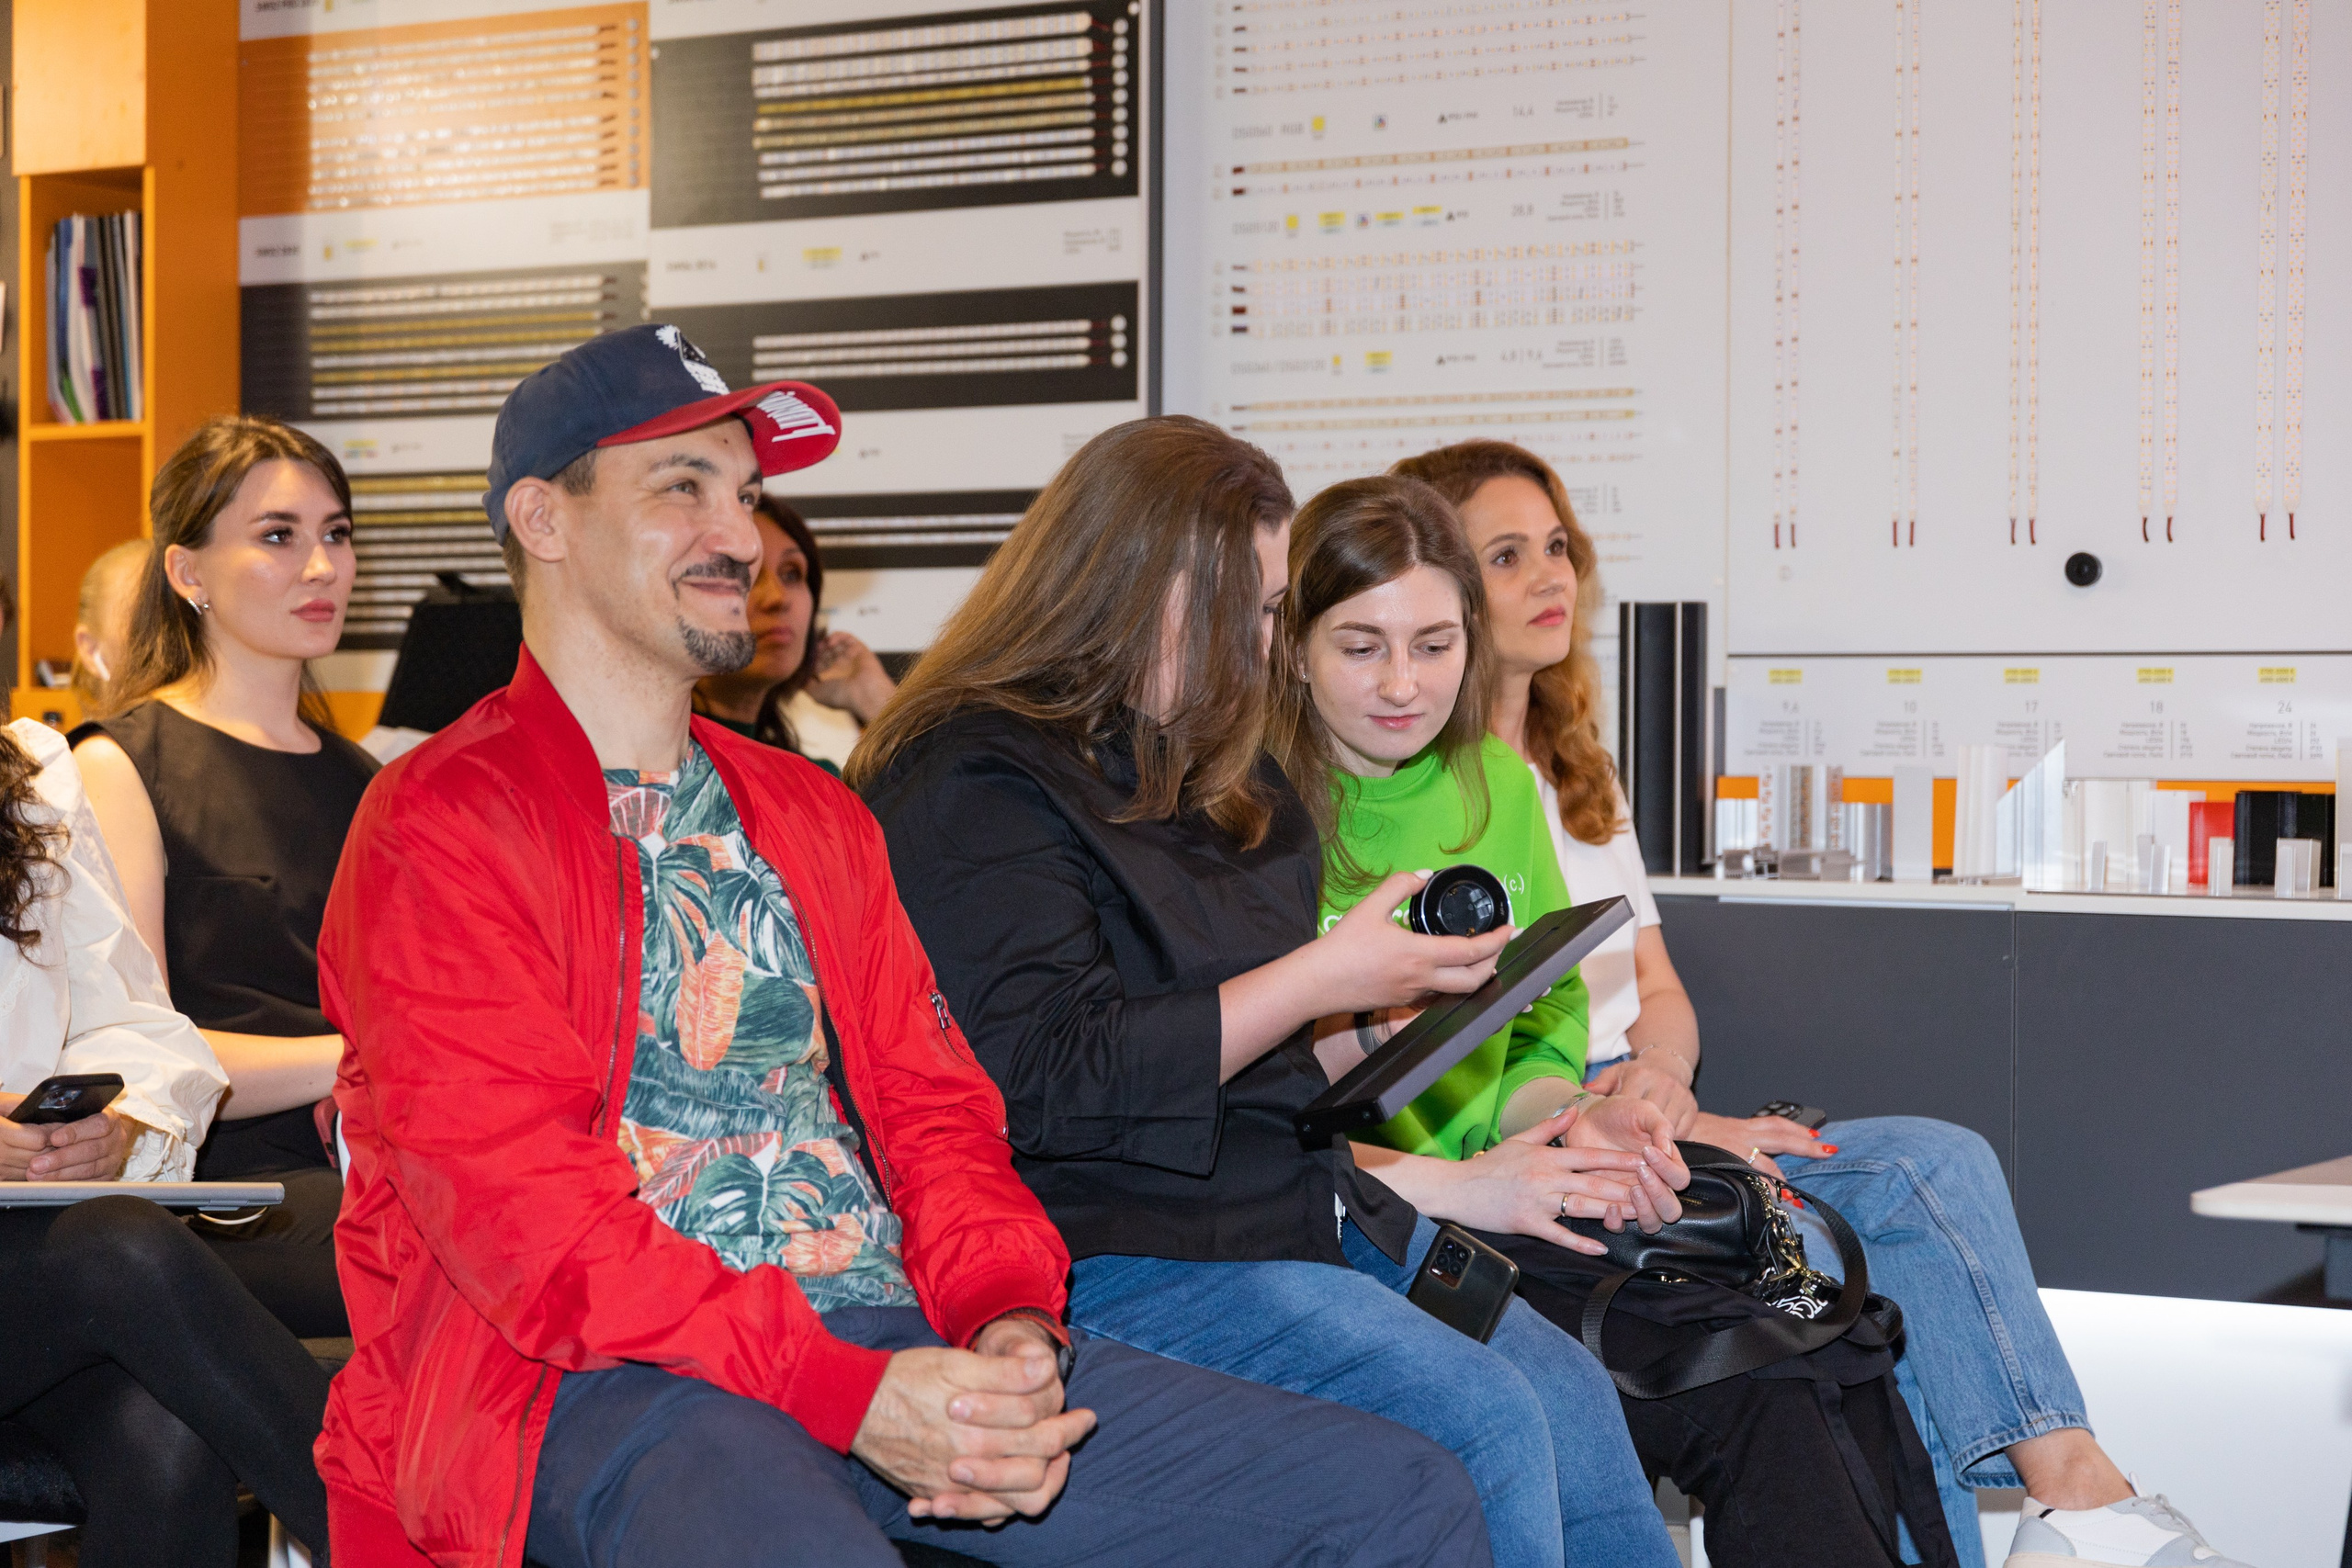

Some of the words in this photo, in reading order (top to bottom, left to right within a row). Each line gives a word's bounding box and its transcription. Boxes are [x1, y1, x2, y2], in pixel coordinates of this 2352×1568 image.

[2025, 700, 2039, 714] 17
[2150, 700, 2164, 714] 18
[2278, 700, 2292, 714] 24
